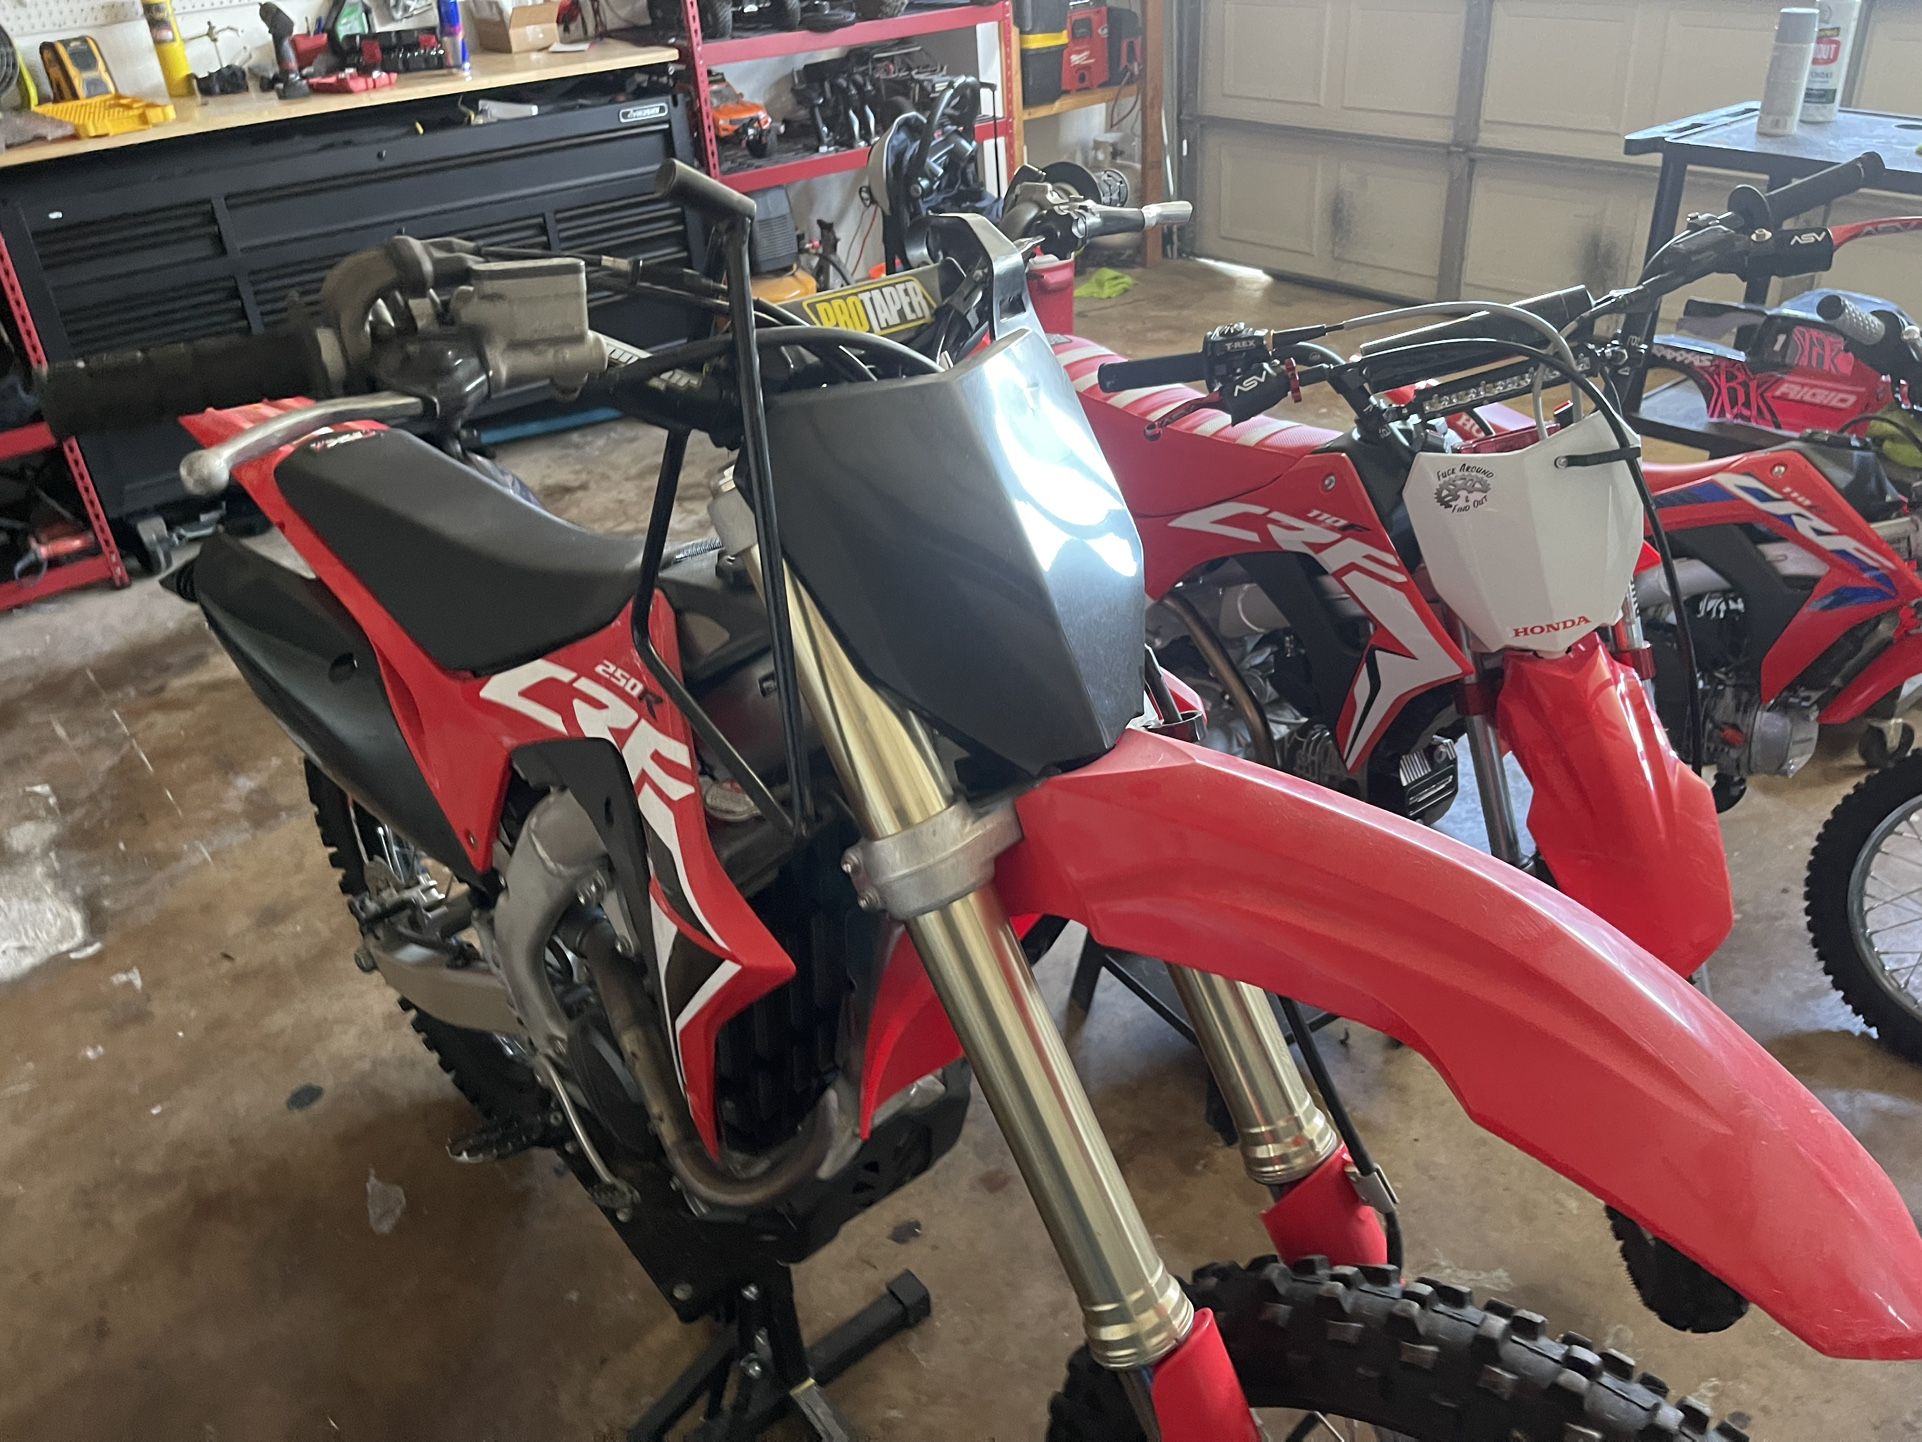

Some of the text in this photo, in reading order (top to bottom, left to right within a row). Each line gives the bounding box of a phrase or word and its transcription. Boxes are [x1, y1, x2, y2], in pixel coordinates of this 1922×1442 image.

[1790, 232, 1826, 245] ASV
[1225, 340, 1256, 351] T-REX
[1233, 371, 1267, 397] ASV
[1772, 383, 1857, 409] RIGID
[1437, 463, 1494, 481] FUCK AROUND
[1451, 495, 1488, 513] FIND OUT
[1306, 509, 1371, 533] 110F
[1168, 501, 1408, 583] CRF
[1513, 615, 1592, 637] HONDA
[595, 660, 663, 721] 250R
[479, 658, 696, 801] CRF
